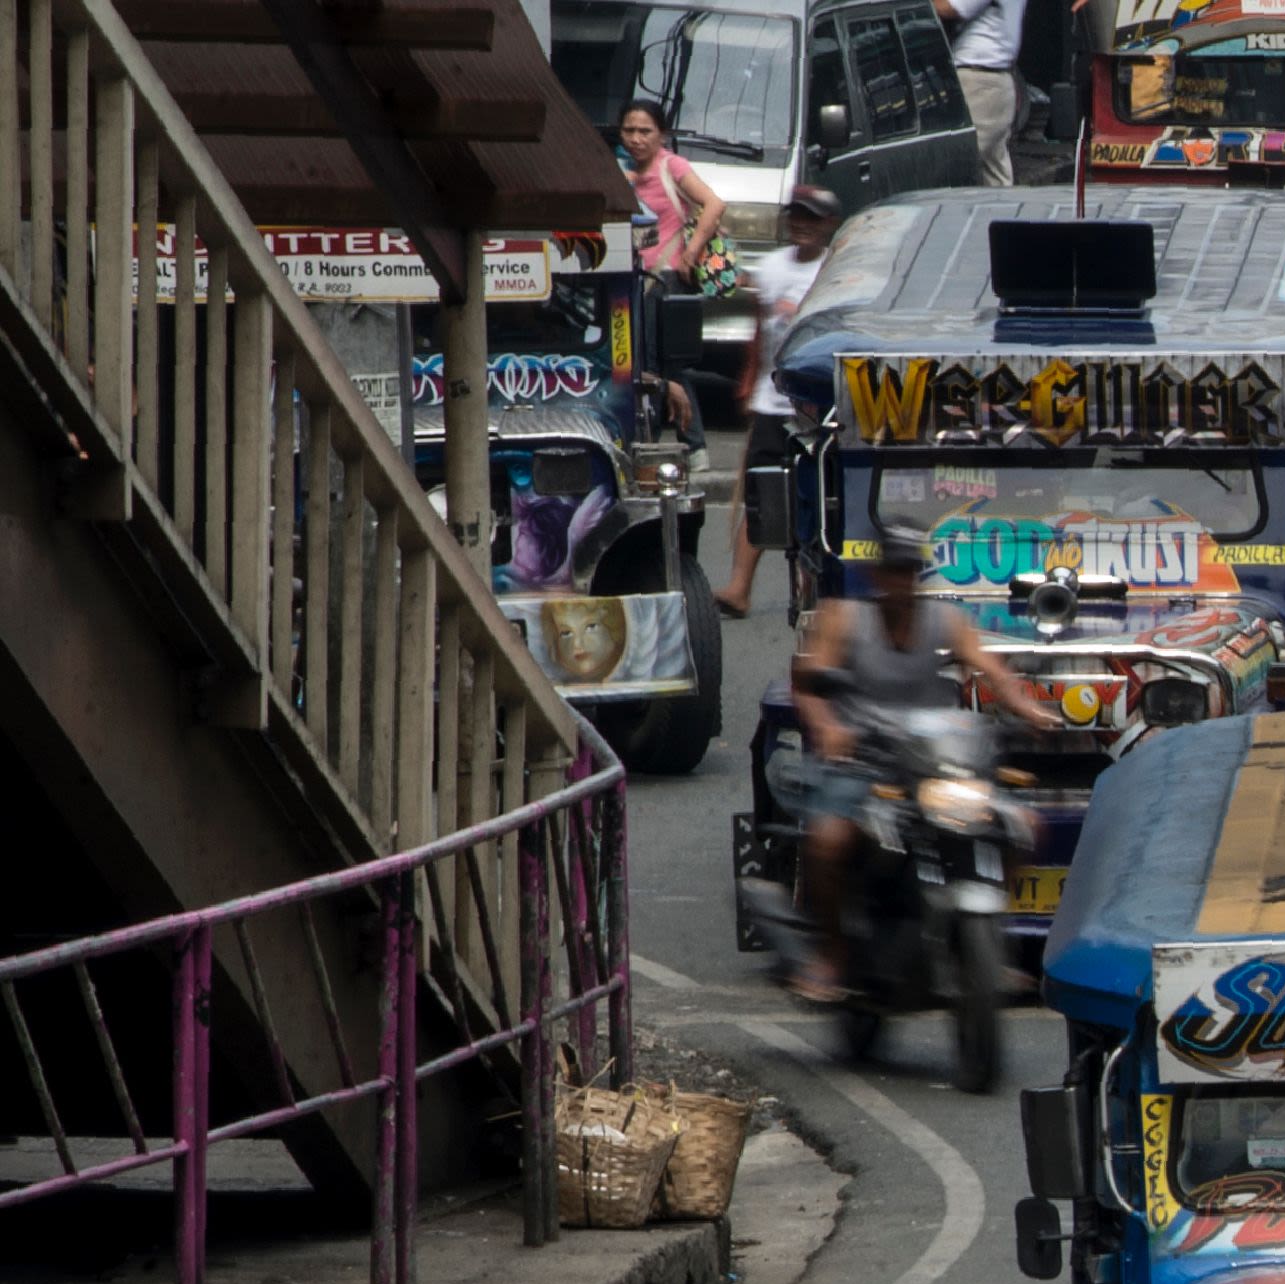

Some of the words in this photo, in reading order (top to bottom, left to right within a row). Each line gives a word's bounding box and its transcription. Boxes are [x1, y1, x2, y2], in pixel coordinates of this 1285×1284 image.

[1094, 144, 1145, 163] PADILLA
[304, 261, 313, 277] 8
[319, 260, 366, 277] Hours
[480, 261, 530, 276] ervice
[494, 278, 536, 291] MMDA
[931, 518, 1054, 585] GOD
[1213, 547, 1285, 564] PADILLA
